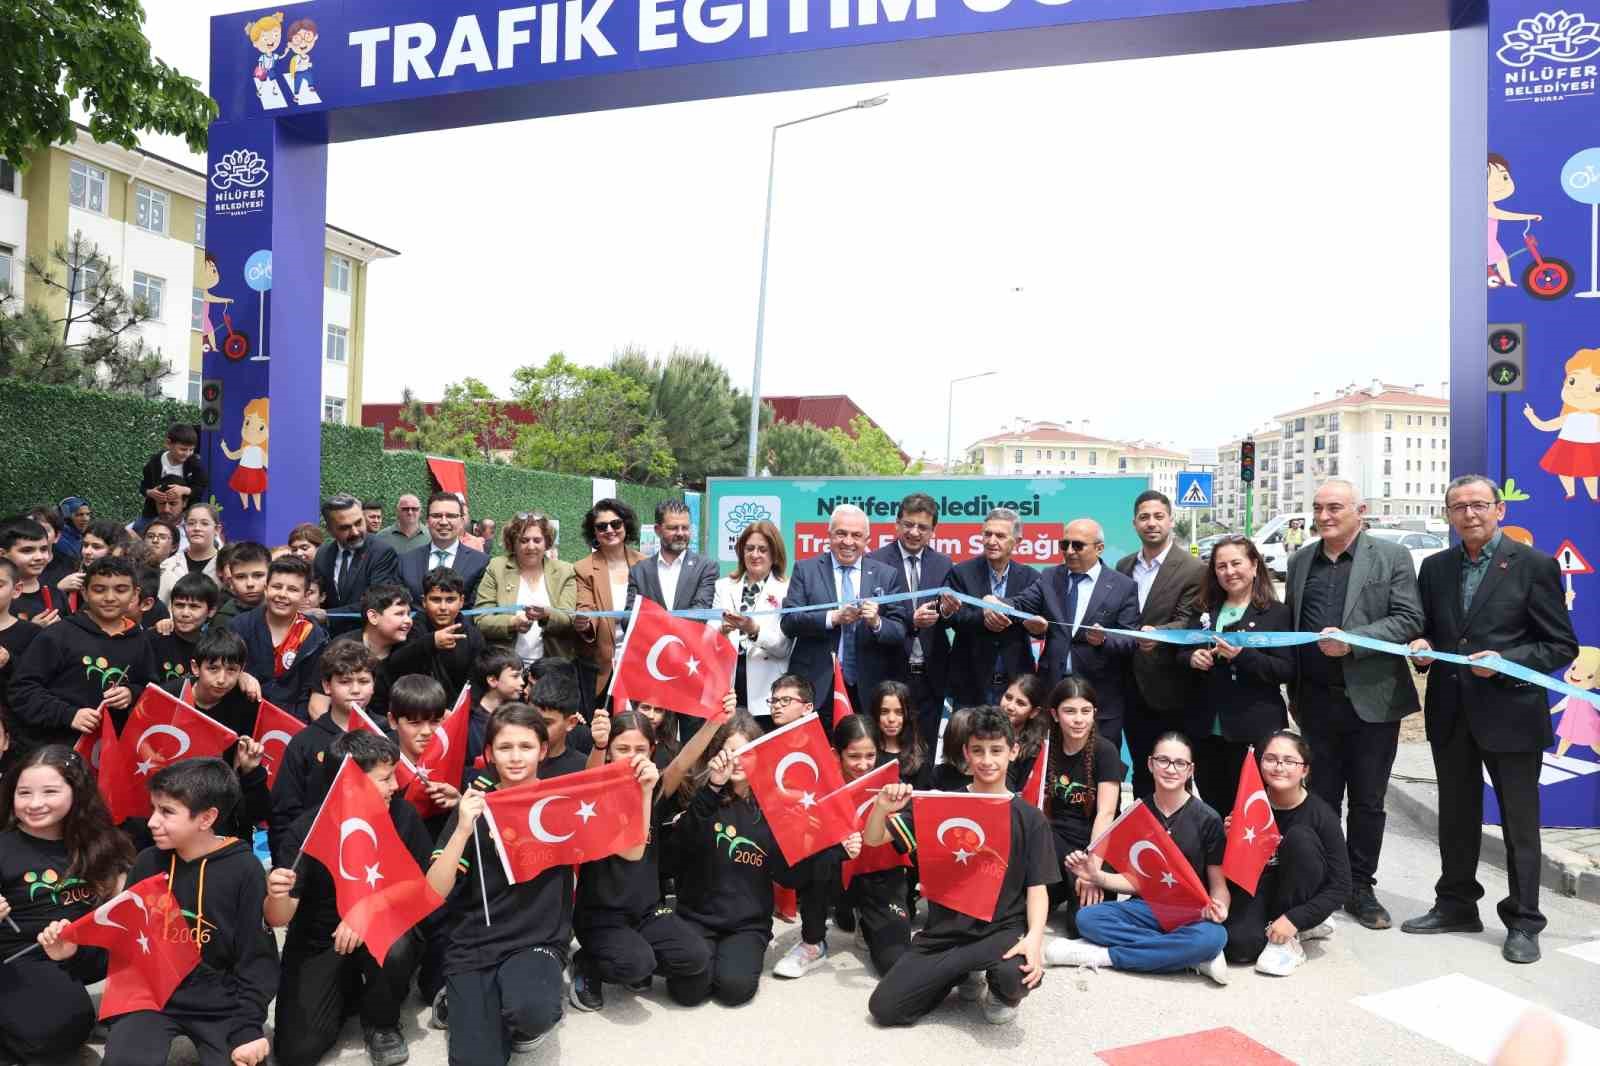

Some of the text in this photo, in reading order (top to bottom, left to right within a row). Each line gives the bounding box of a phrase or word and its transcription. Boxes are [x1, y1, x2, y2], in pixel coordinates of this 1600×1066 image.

[1505, 65, 1597, 83] NİLÜFER
[1505, 79, 1595, 97] BELEDİYESİ
[215, 189, 265, 201] NİLÜFER
[215, 199, 264, 211] BELEDİYESİ
[734, 850, 763, 867] 2006
[170, 927, 211, 943] 2006
